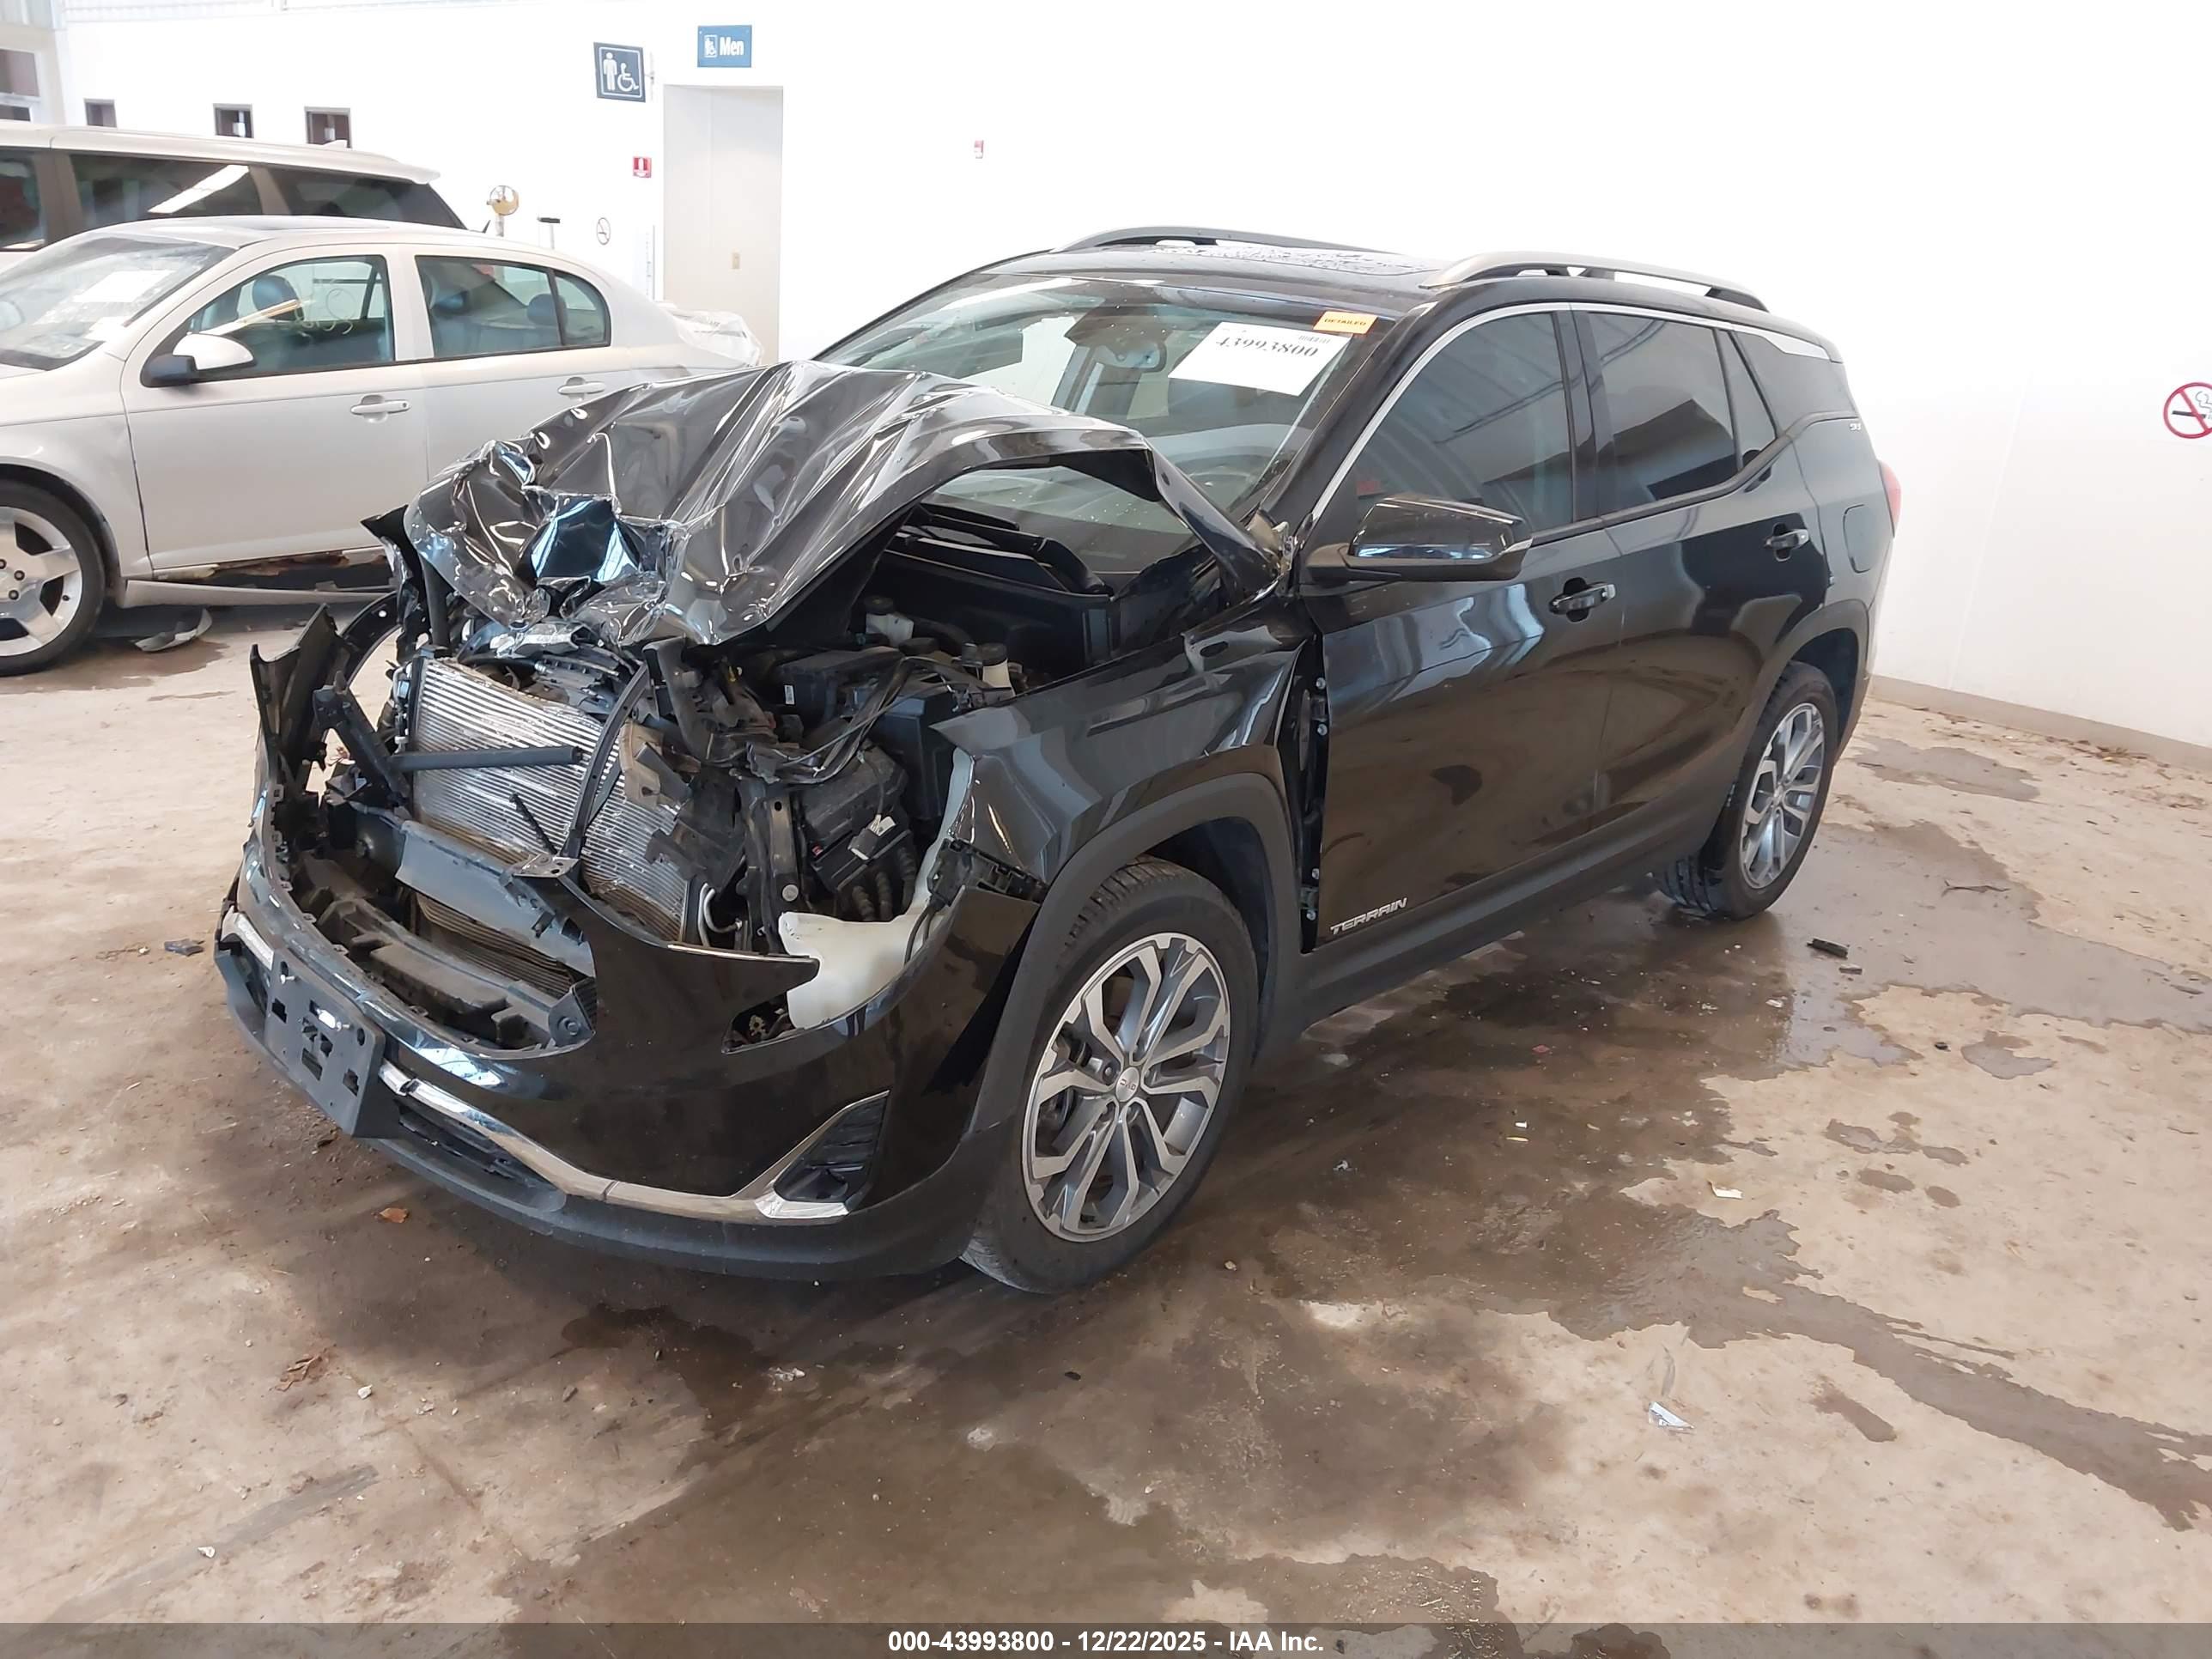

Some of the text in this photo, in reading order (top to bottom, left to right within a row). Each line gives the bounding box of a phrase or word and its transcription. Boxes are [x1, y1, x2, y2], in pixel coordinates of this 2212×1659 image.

[719, 36, 744, 56] Men
[1323, 318, 1367, 326] DETAILED
[1216, 337, 1319, 356] 43993800
[1329, 897, 1408, 935] TERRAIN
